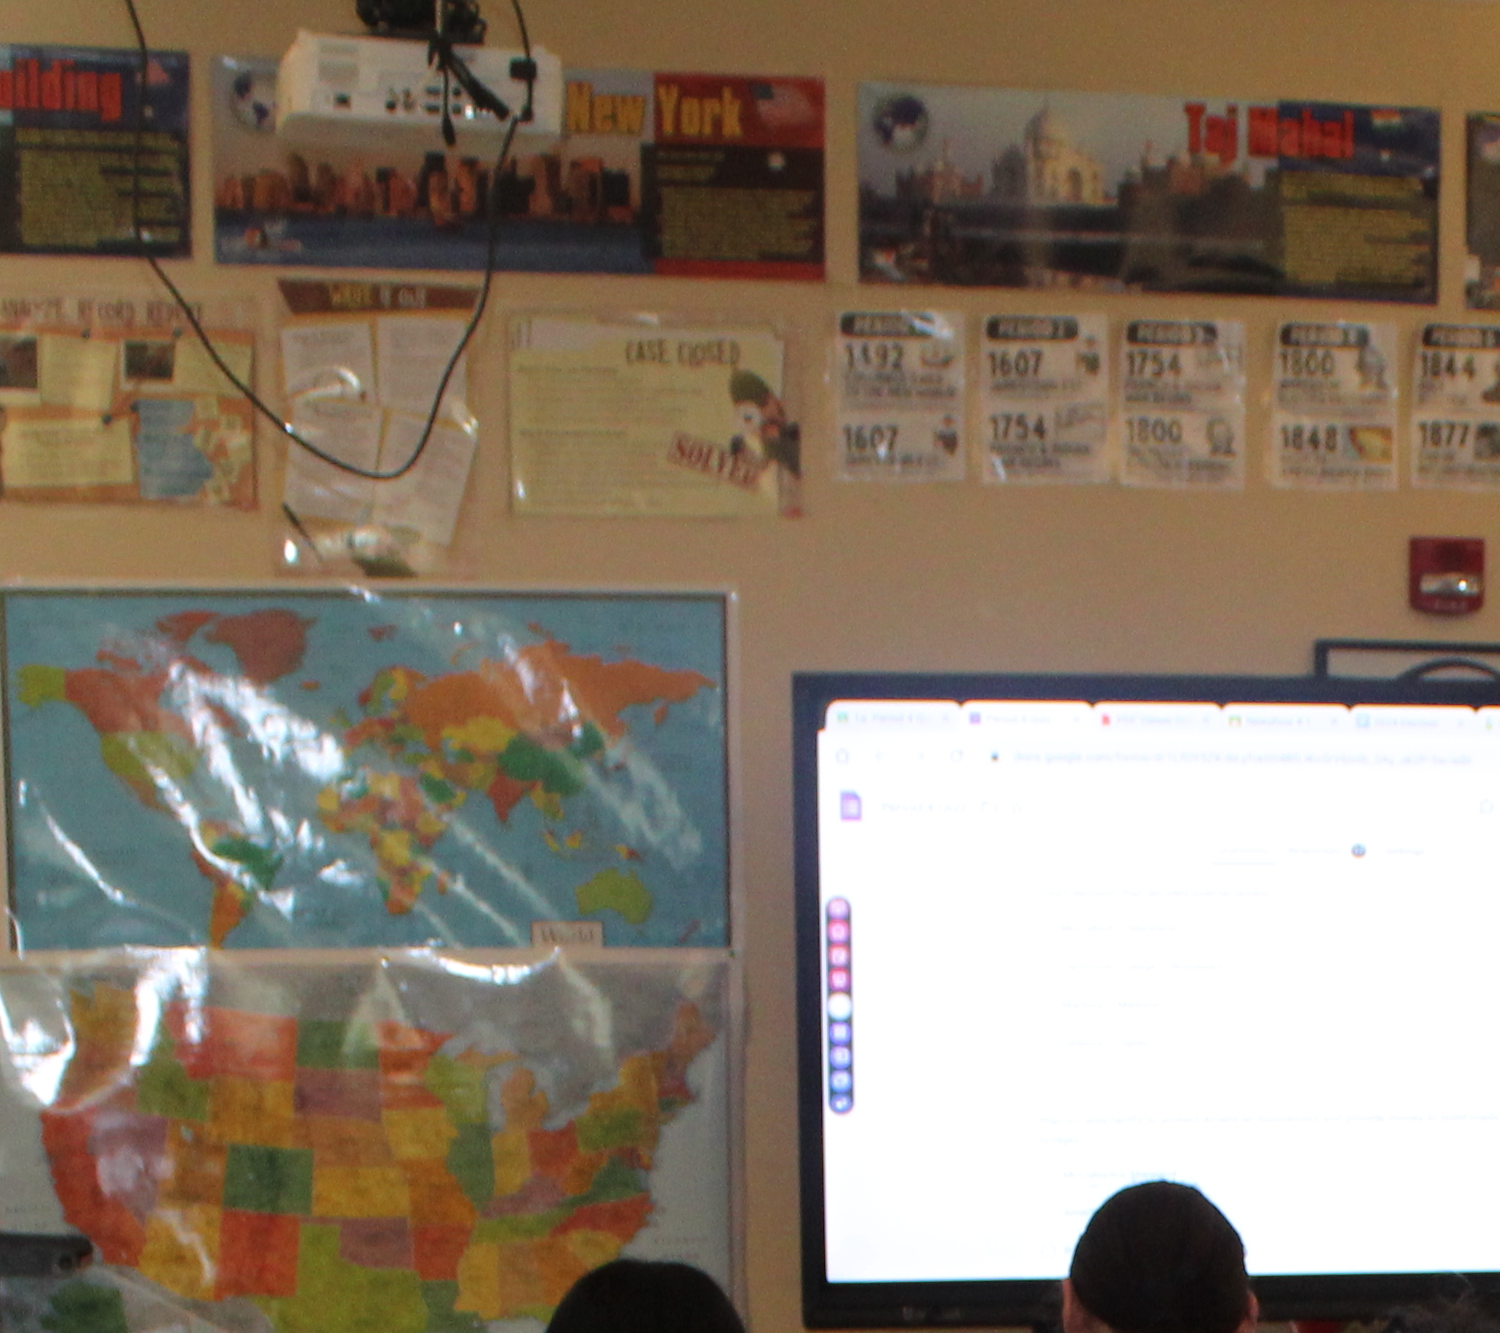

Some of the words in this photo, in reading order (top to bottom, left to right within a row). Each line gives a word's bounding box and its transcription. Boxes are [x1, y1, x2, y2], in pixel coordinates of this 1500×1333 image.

[565, 79, 646, 137] New
[656, 82, 743, 139] York
[1184, 102, 1238, 164] Taj
[1247, 106, 1355, 159] Mahal
[625, 341, 672, 363] CASE
[678, 342, 740, 365] CLOSED
[989, 352, 1043, 375] 1607
[1128, 351, 1182, 377] 1754
[1279, 350, 1334, 376] 1800
[843, 424, 899, 450] 1607
[990, 414, 1046, 440] 1754
[1127, 417, 1183, 444] 1800
[1280, 425, 1338, 451] 1848
[1419, 421, 1470, 448] 1877
